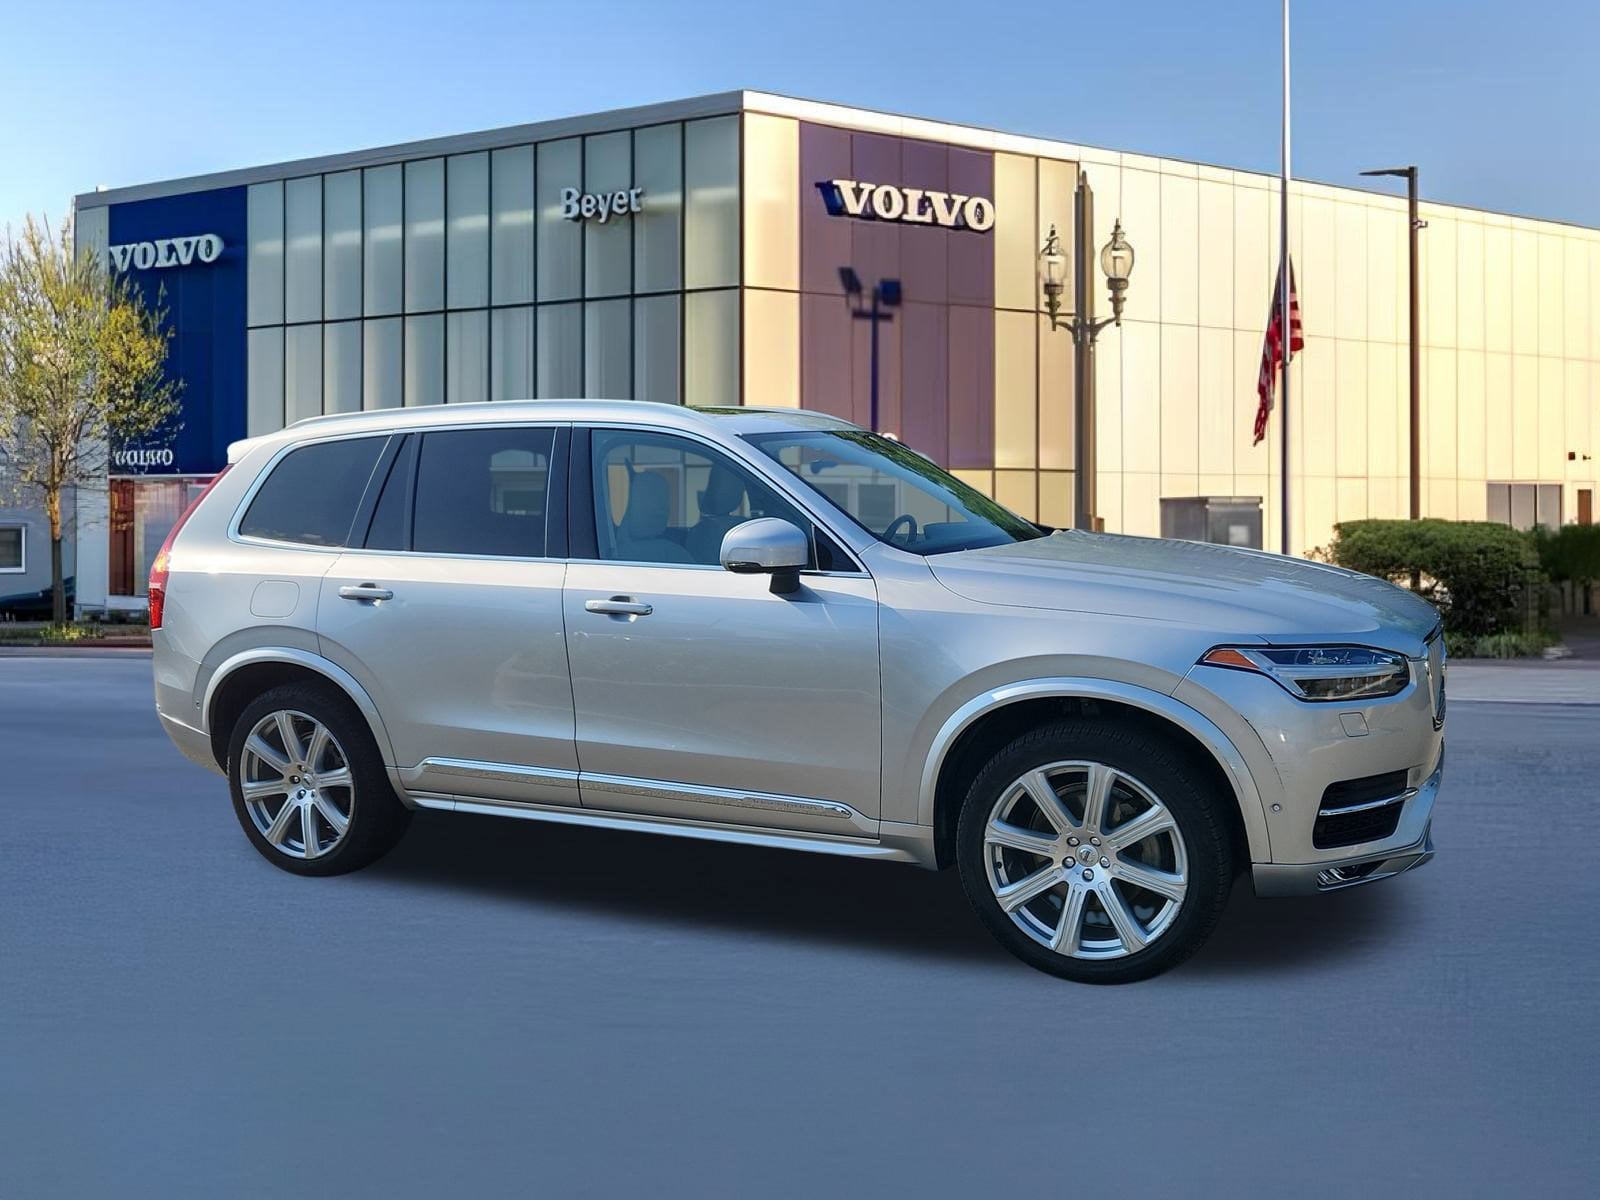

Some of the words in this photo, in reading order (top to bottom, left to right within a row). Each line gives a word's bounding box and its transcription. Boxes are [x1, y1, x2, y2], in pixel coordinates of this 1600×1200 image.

[560, 187, 642, 224] Beyer
[832, 179, 996, 232] VOLVO
[109, 233, 224, 272] VOLVO
